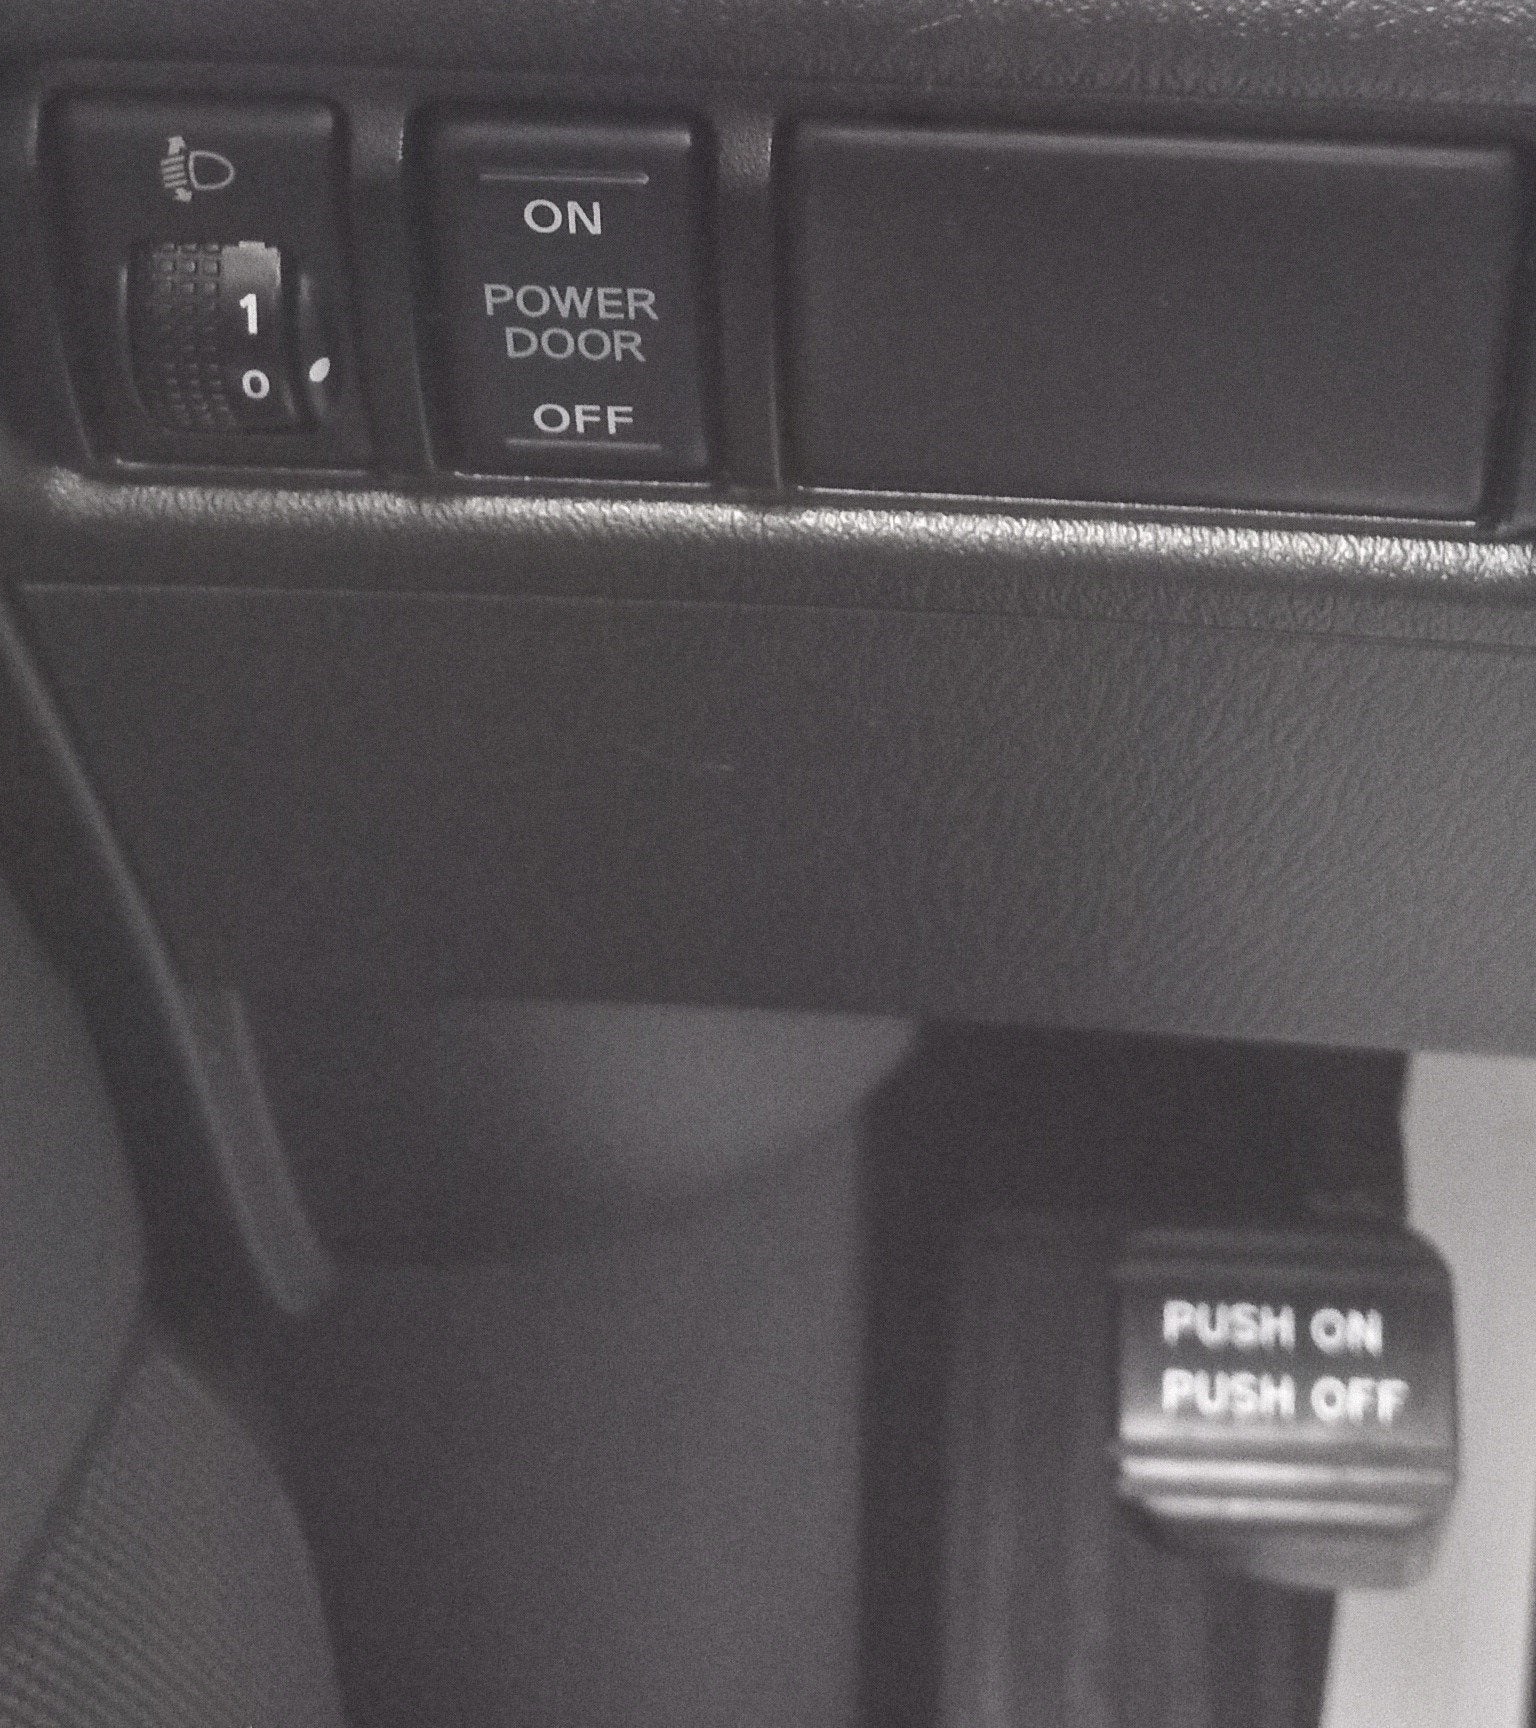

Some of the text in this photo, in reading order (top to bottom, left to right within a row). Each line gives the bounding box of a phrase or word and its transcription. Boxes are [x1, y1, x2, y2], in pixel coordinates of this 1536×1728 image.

[523, 198, 602, 235] ON
[238, 292, 259, 336] 1
[483, 282, 659, 321] POWER
[505, 326, 647, 362] DOOR
[533, 402, 634, 435] OFF
[1162, 1298, 1385, 1357] PUSH ON
[1162, 1368, 1411, 1426] PUSH OFF
